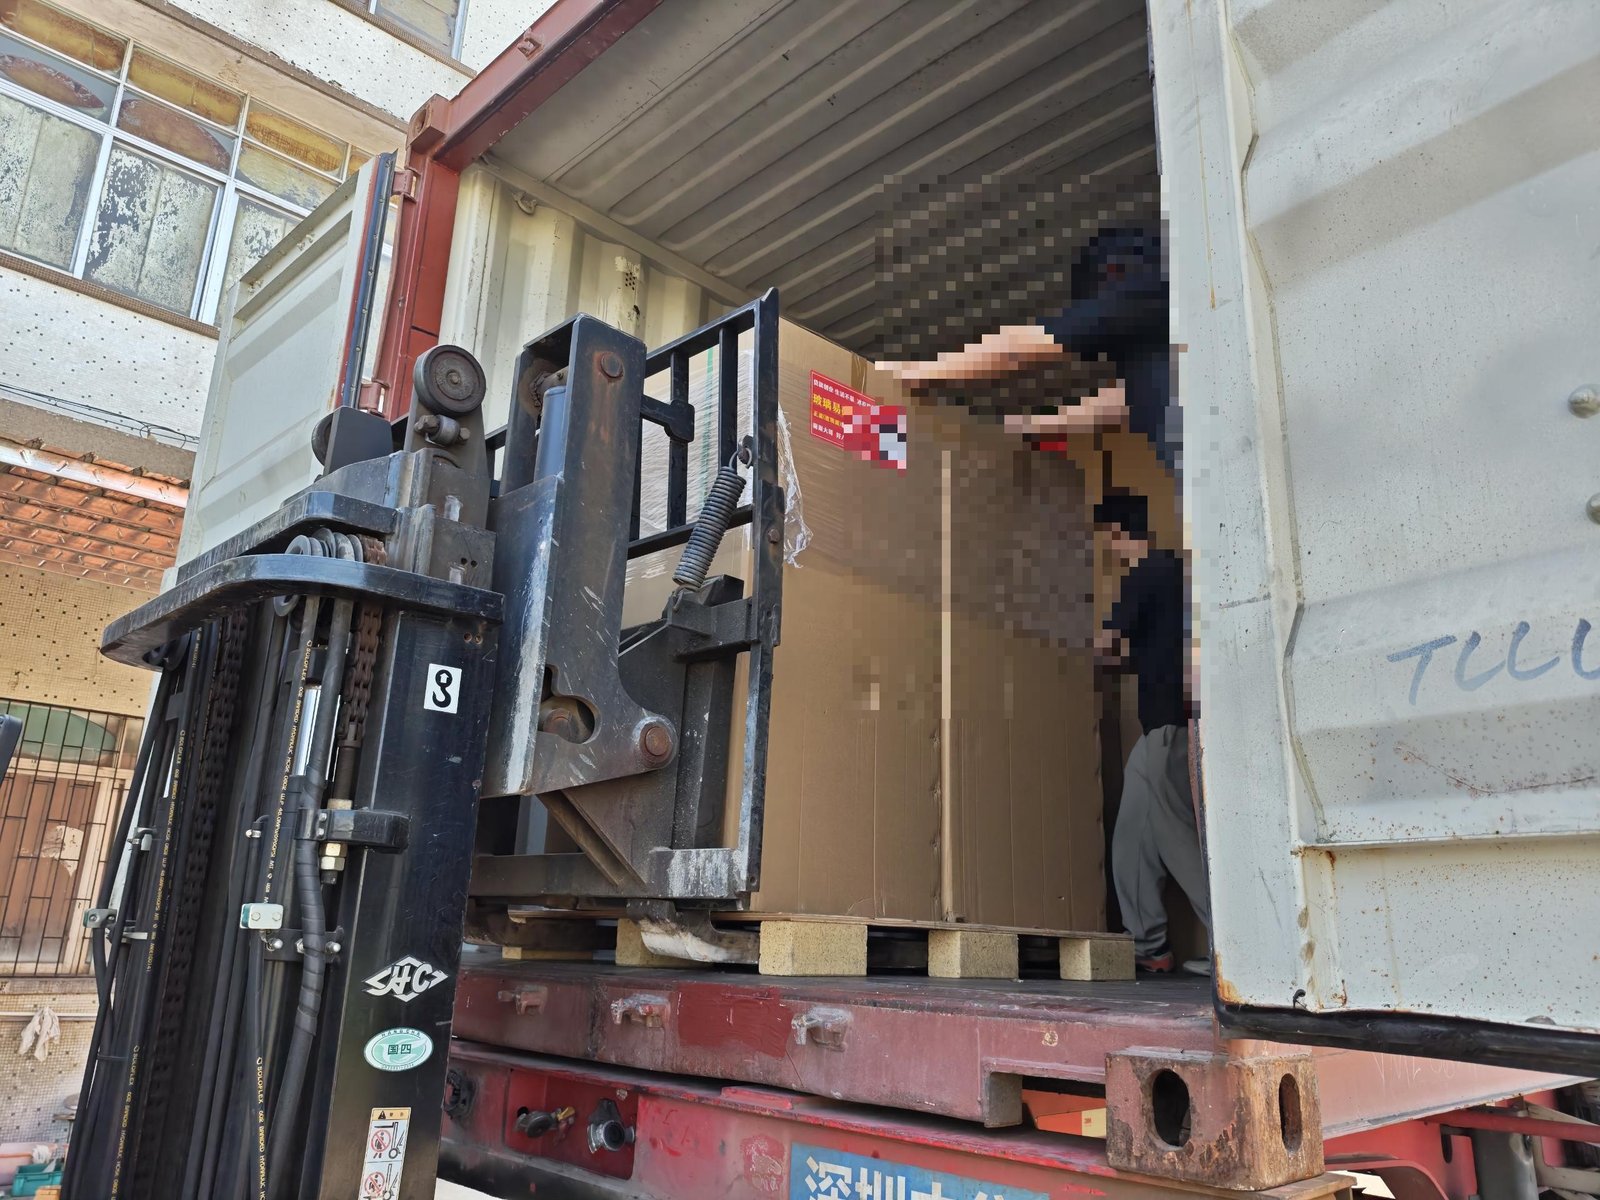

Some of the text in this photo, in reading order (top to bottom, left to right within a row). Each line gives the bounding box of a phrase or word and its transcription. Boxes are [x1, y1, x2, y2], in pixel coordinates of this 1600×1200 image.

[812, 393, 843, 415] 玻璃易
[387, 1044, 412, 1055] 国四
